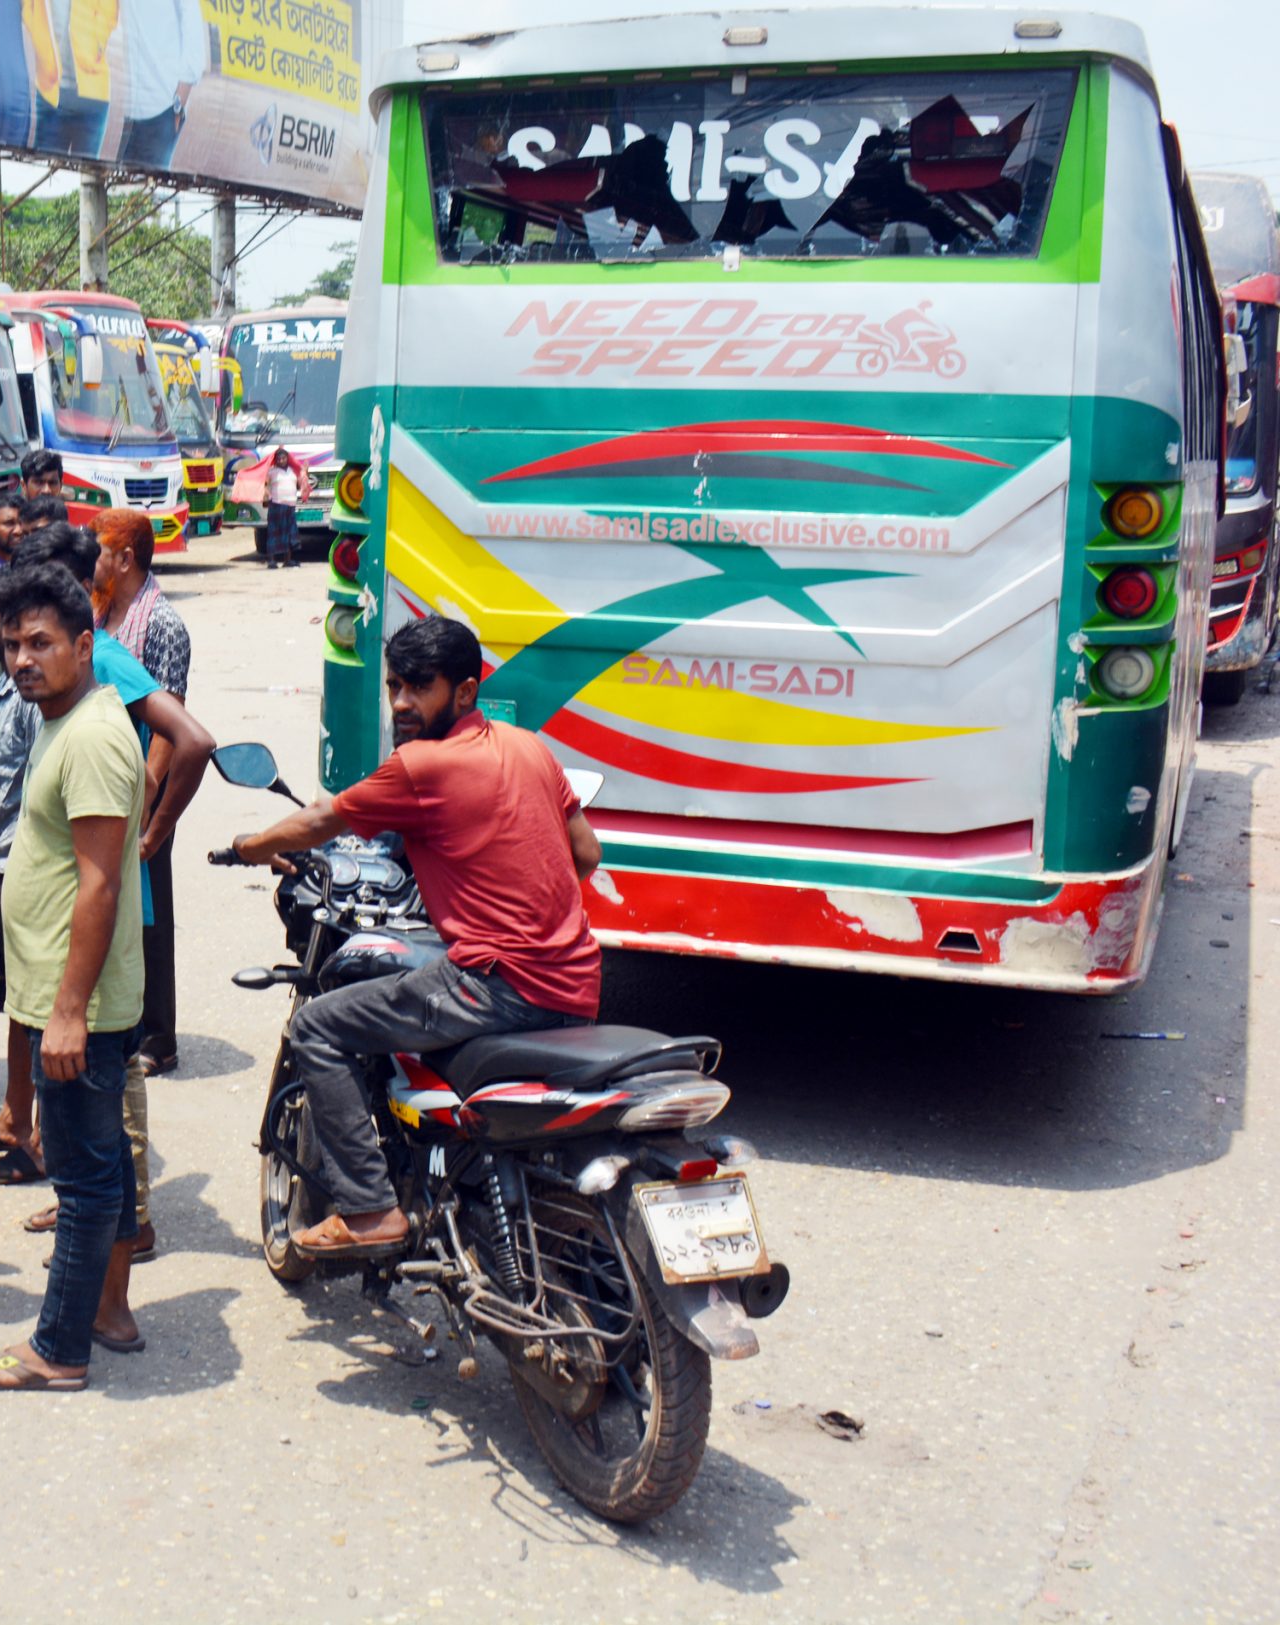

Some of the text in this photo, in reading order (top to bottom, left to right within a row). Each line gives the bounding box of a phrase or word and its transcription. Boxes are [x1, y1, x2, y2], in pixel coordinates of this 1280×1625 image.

[227, 33, 358, 102] বেস্ট কোয়ালিটি রডে
[279, 113, 336, 159] BSRM
[251, 319, 344, 346] B.M.
[503, 299, 867, 337] NEED FOR
[517, 339, 844, 377] SPEED
[486, 511, 951, 550] www.samisadiexclusive.com
[622, 656, 855, 697] SAMI-SADI
